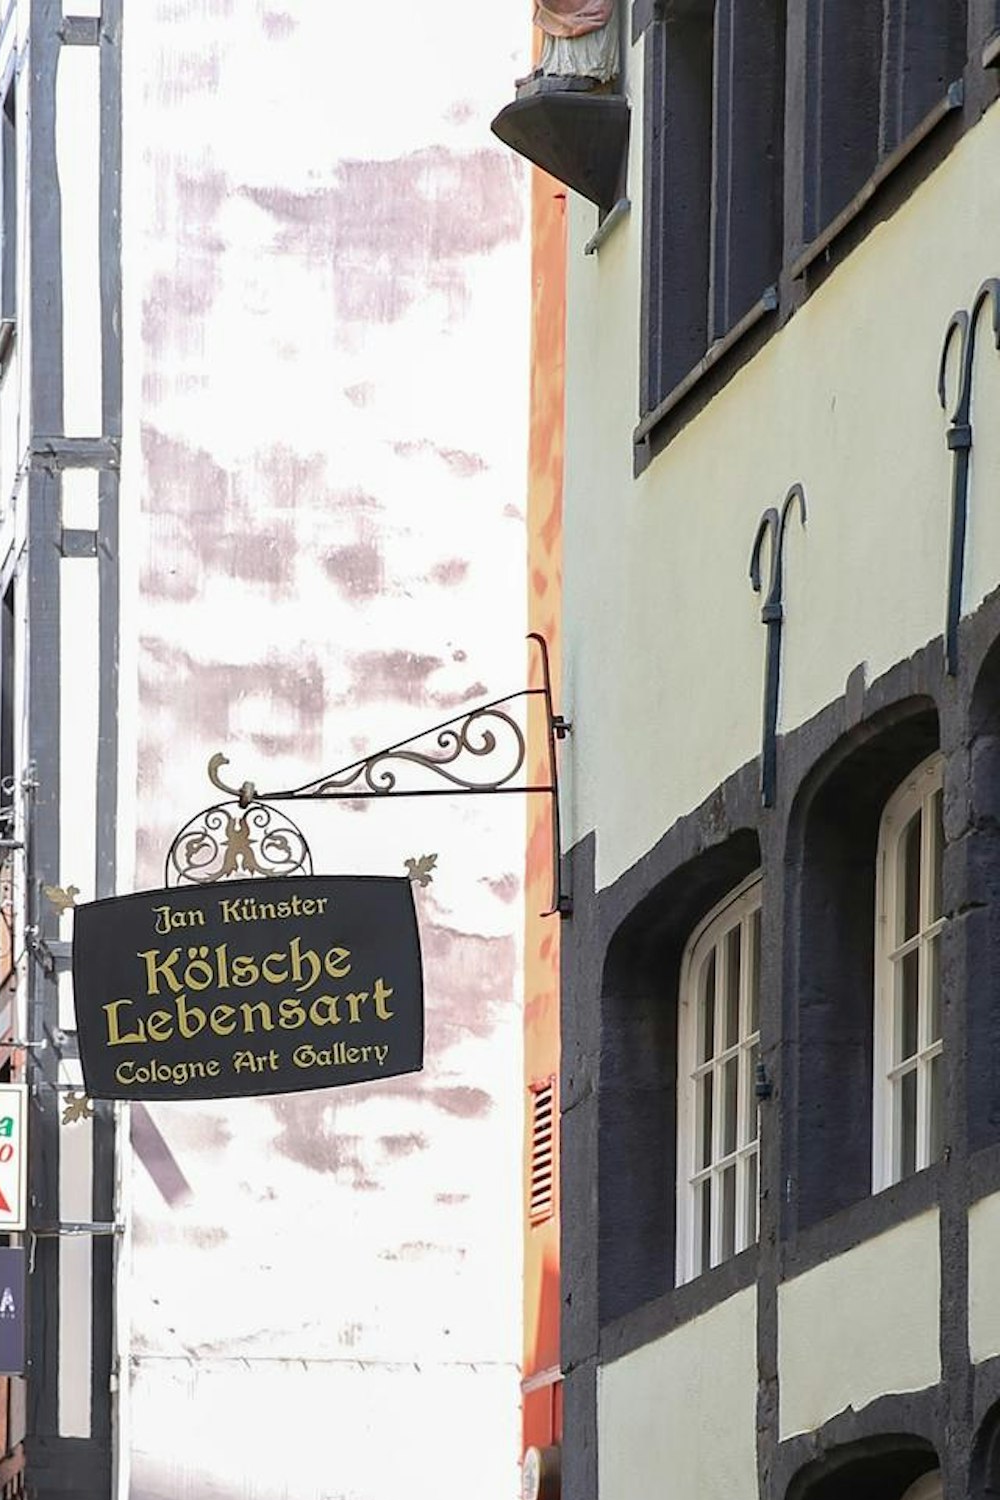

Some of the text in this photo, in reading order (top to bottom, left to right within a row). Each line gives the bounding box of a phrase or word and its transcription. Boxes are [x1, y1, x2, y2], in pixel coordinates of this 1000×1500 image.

[152, 895, 328, 935] Jan Künster
[137, 936, 352, 995] Kölsche
[101, 977, 395, 1047] Lebensart
[115, 1041, 390, 1086] Cologne Art Gallery
